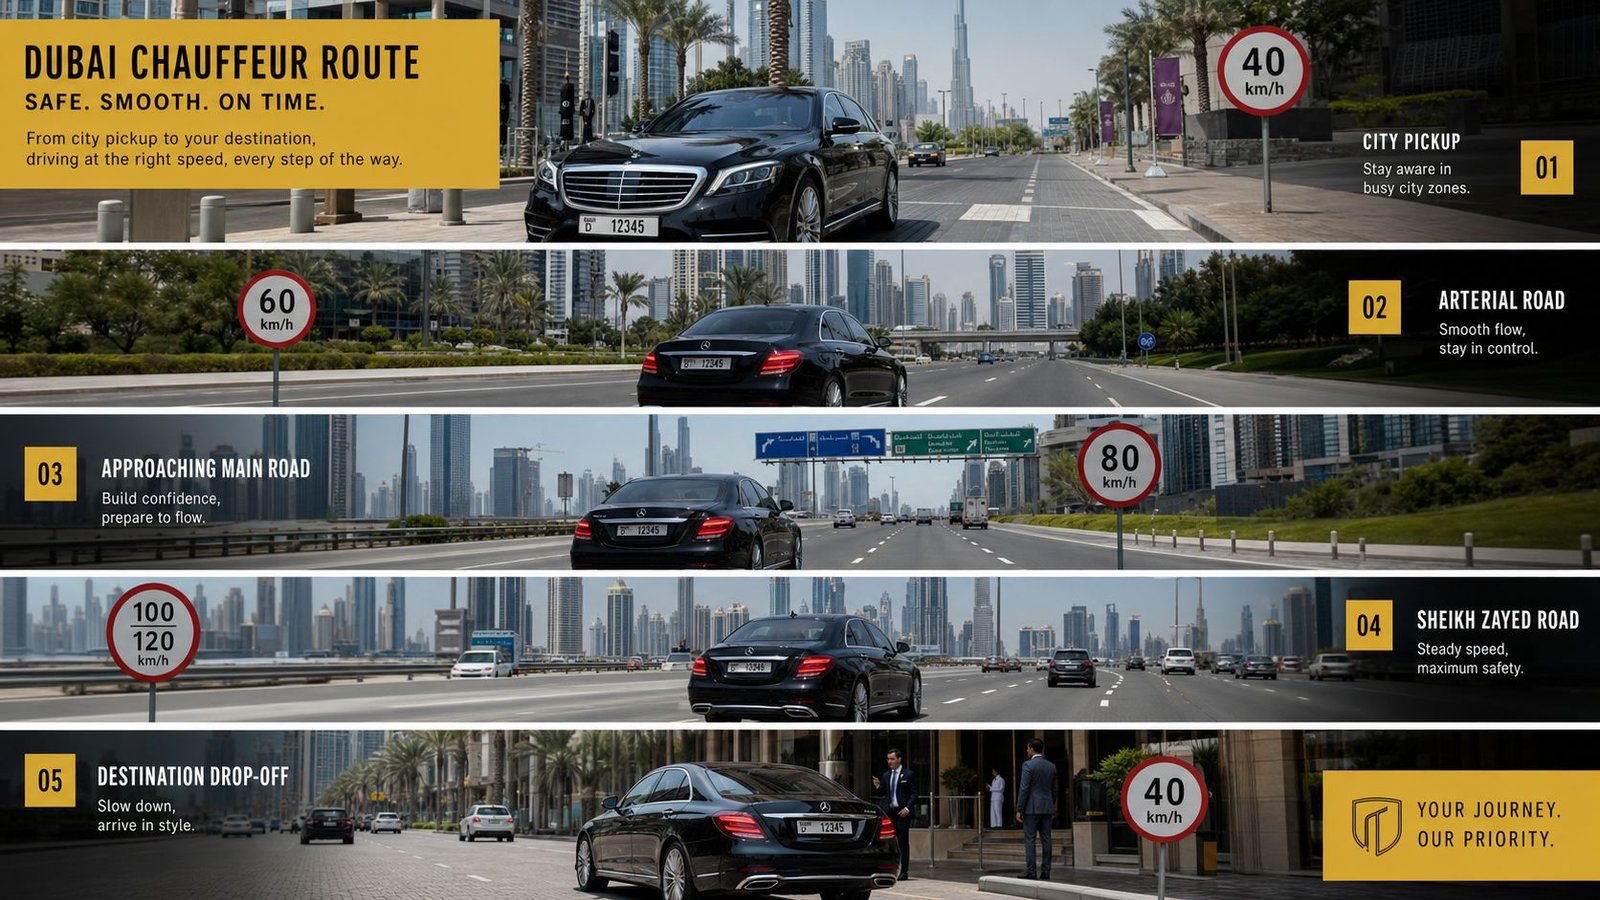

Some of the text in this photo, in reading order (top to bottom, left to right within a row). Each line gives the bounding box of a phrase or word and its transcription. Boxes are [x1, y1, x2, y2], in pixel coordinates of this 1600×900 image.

[1242, 47, 1284, 76] 40
[1246, 81, 1284, 96] km/h
[585, 219, 645, 234] D 12345
[260, 289, 295, 314] 60
[261, 318, 293, 331] km/h
[1102, 445, 1139, 471] 80
[1103, 476, 1136, 489] km/h
[638, 526, 660, 535] 12345
[134, 602, 174, 622] 100
[134, 631, 174, 651] 120
[138, 655, 168, 666] km/h
[1144, 778, 1184, 806] 40
[1147, 811, 1182, 824] km/h
[820, 823, 844, 833] 12345
